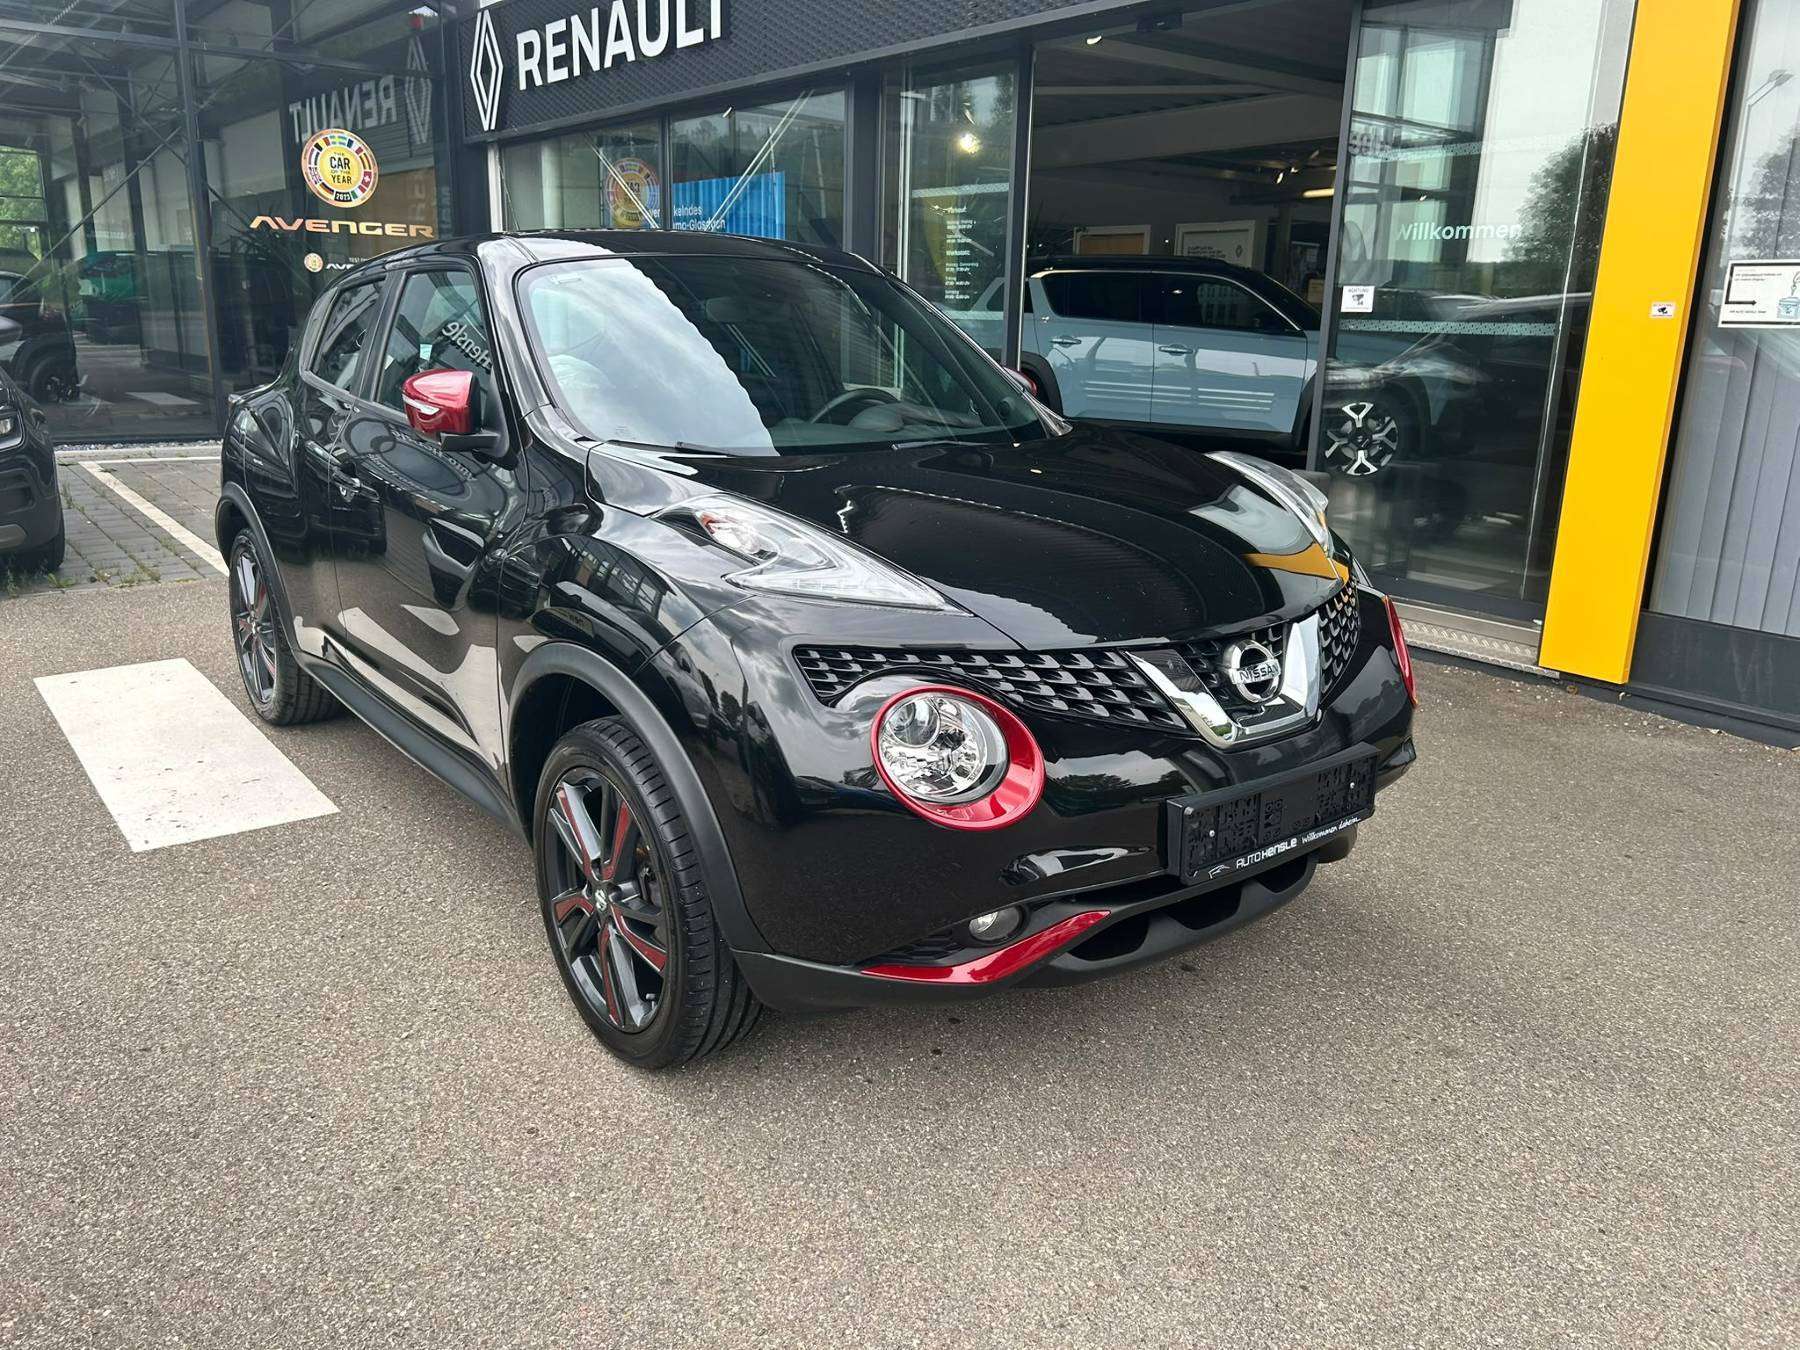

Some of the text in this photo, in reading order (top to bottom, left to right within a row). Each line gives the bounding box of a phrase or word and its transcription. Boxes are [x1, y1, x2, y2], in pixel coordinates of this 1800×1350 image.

[329, 156, 351, 170] CAR
[331, 174, 352, 185] YEAR
[250, 215, 435, 239] AVENGER
[1240, 662, 1279, 681] NISSAN
